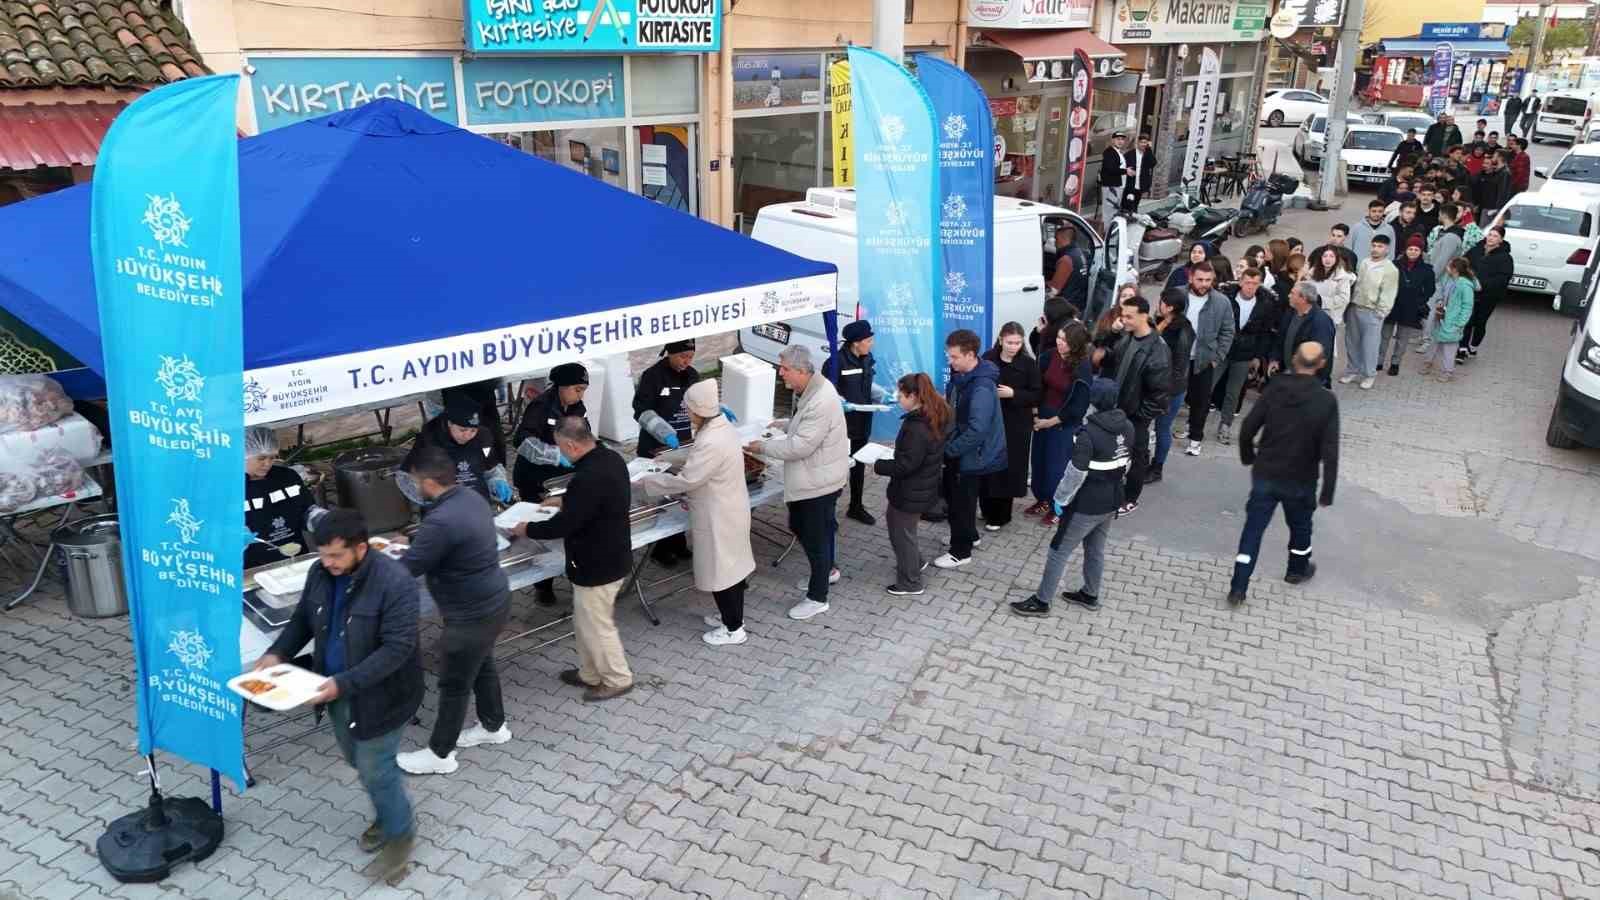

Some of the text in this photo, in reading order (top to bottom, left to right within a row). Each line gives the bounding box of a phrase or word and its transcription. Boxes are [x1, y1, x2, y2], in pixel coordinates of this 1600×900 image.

[639, 20, 712, 43] KIRTASİYE
[262, 72, 614, 113] KIRTASİYE FOTOKOPİ
[164, 253, 206, 270] AYDIN
[116, 257, 223, 296] ÜYÜKŞEHR
[136, 282, 215, 307] BELEDİYESİ
[347, 363, 393, 389] T.C.
[402, 349, 474, 380] AYDIN
[483, 314, 643, 365] BÜYÜKŞEHİR
[650, 298, 746, 334] BELEDİYESİ
[272, 385, 328, 402] BÜYÜKŞEHİR
[287, 378, 312, 388] AYDIN
[150, 400, 172, 416] T.C.
[280, 396, 323, 409] BELEDİYESİ
[129, 410, 232, 448] BÜYÜKŞHİR
[149, 434, 211, 458] BELEDİSİ
[181, 550, 214, 563] YDIN
[159, 571, 220, 595] BEDİYESİ
[189, 672, 221, 690] AYDIN
